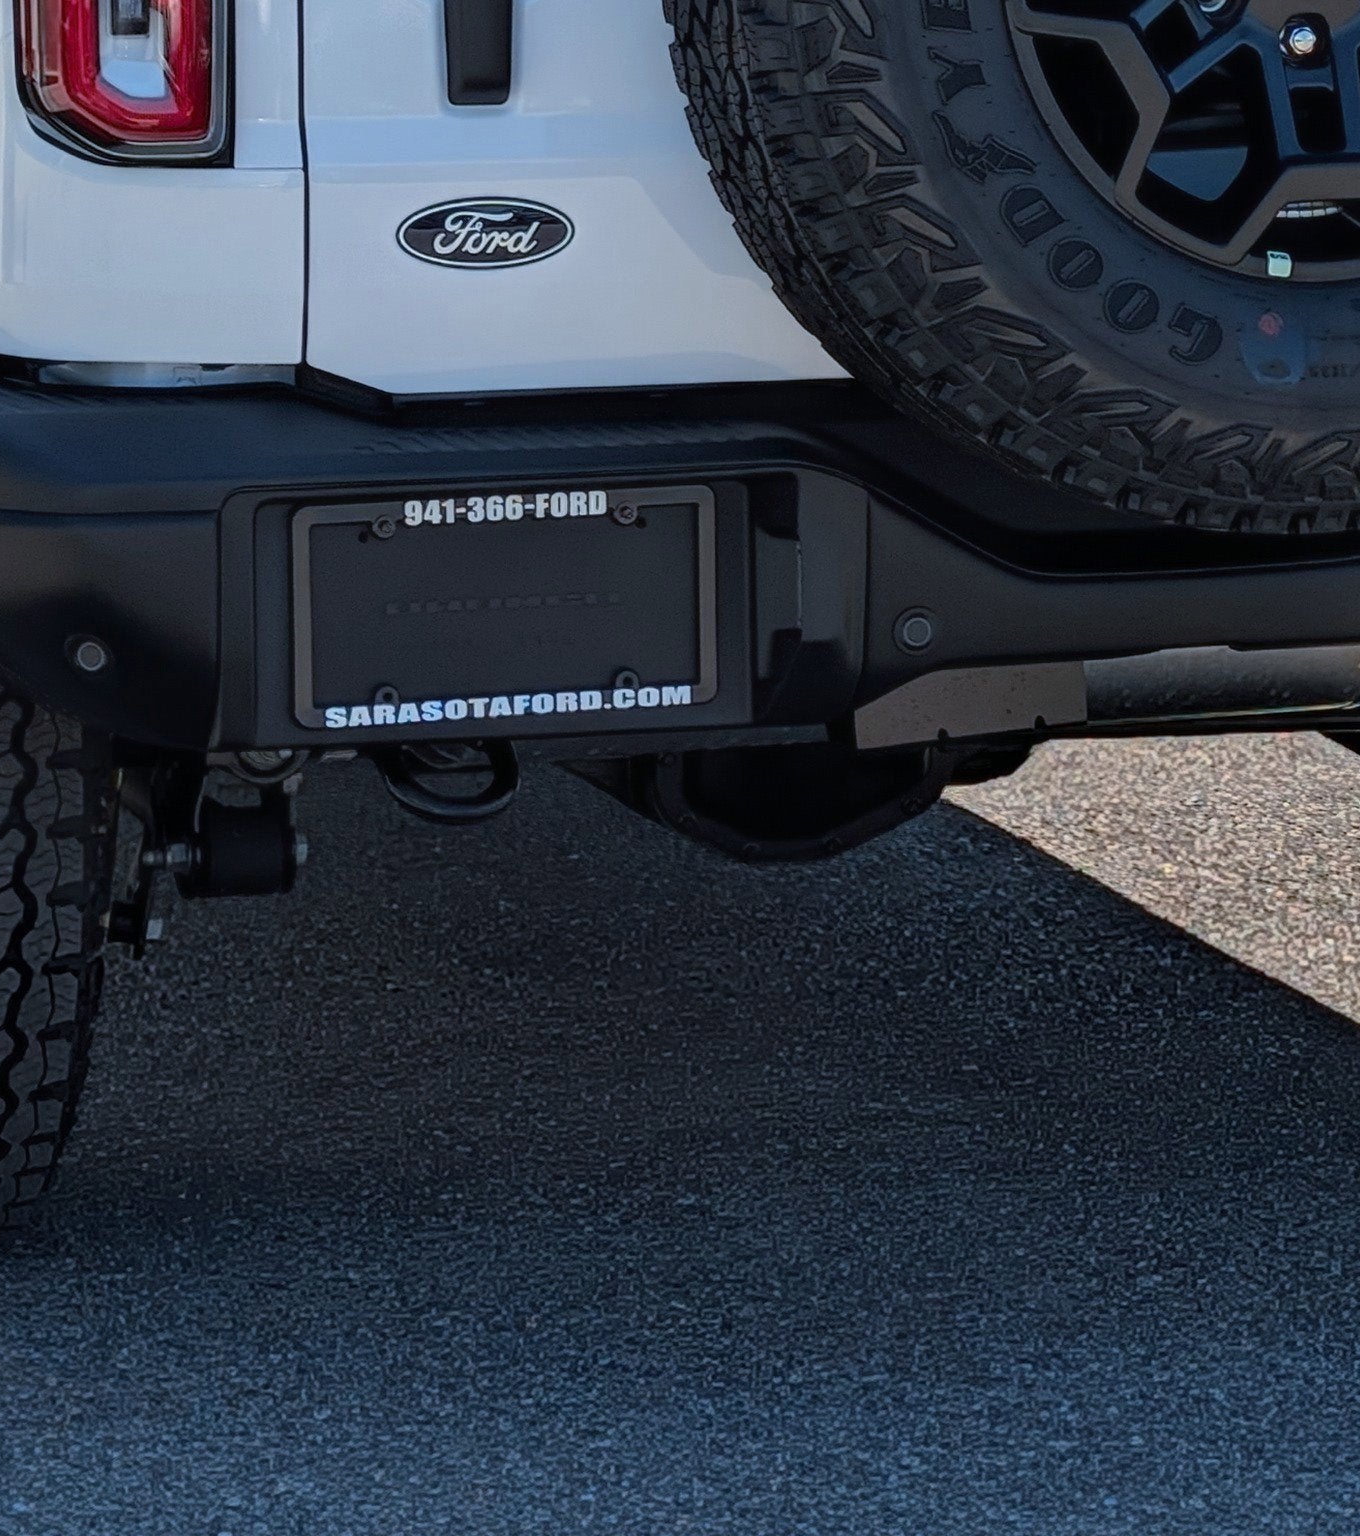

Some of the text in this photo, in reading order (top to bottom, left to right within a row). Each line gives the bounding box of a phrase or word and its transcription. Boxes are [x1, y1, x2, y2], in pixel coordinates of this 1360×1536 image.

[433, 211, 541, 255] Ford
[403, 490, 608, 527] 941-366-FORD
[324, 685, 693, 729] SARASOTAFORD.COM
